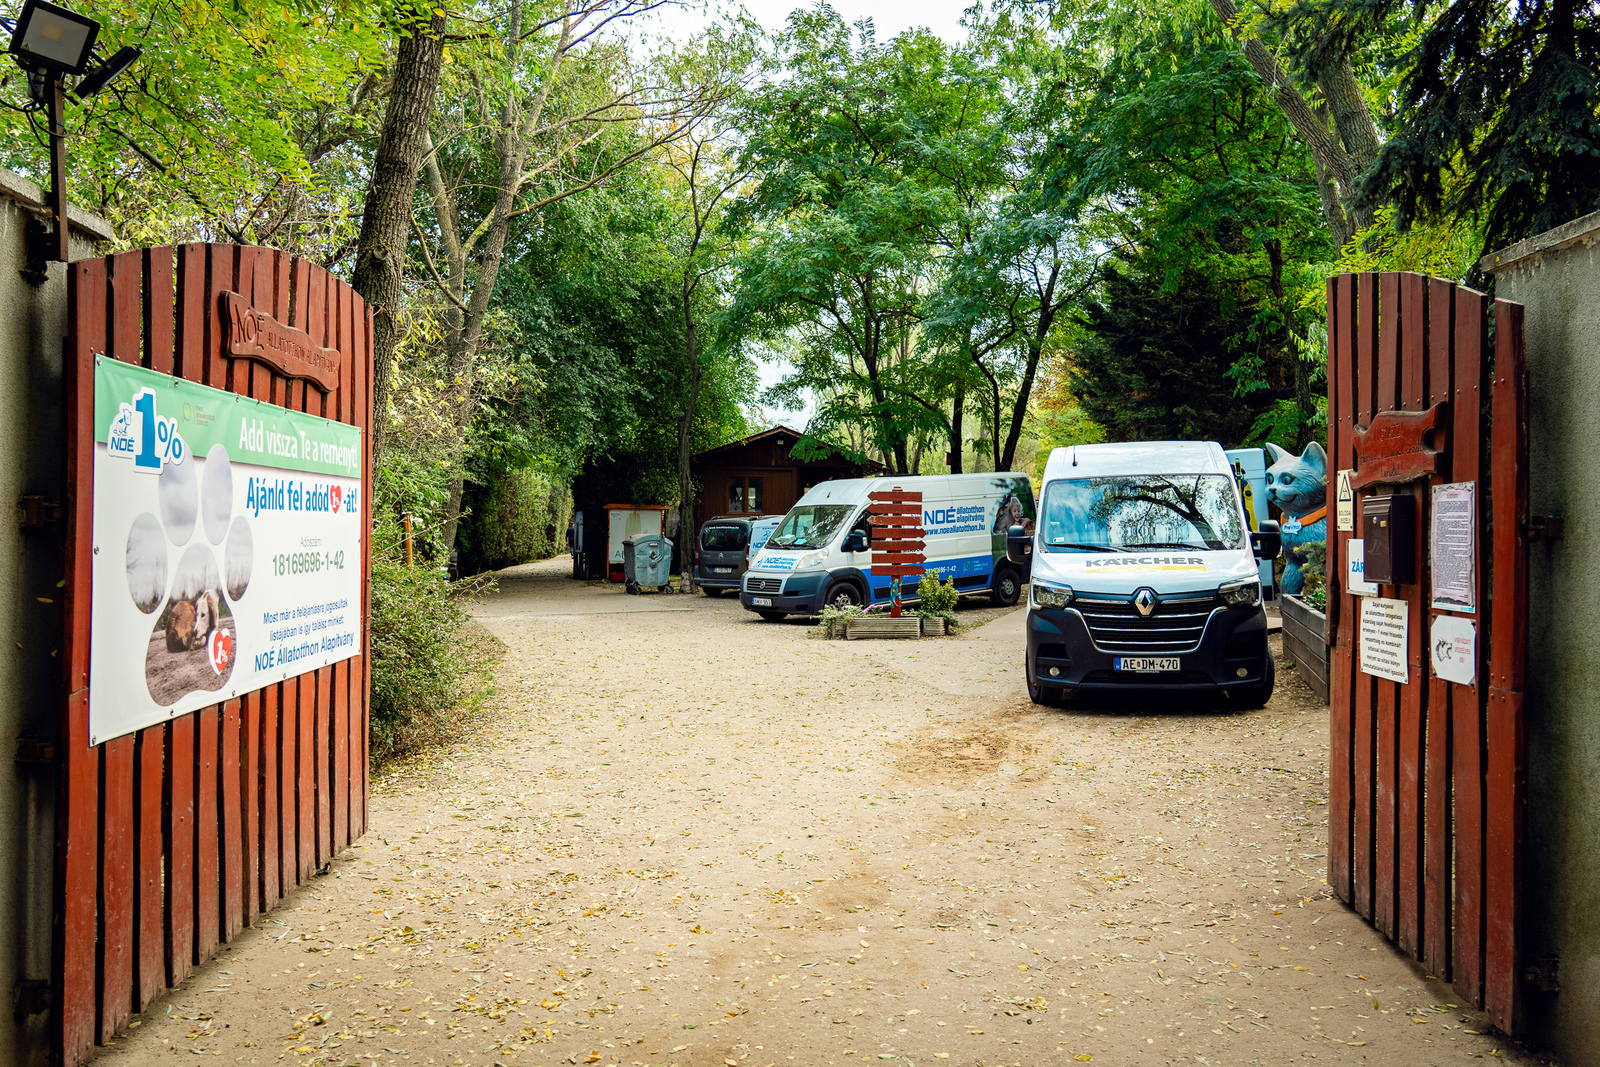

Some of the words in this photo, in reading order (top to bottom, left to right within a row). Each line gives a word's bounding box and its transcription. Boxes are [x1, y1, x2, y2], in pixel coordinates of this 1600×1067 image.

[135, 393, 182, 468] 1%
[111, 437, 134, 452] NOÉ
[239, 417, 264, 453] Add
[266, 424, 298, 458] vissza
[300, 430, 311, 460] Te
[312, 440, 319, 461] a
[320, 438, 358, 474] reményt!
[246, 477, 285, 518] Ajánld
[287, 480, 303, 511] fel
[305, 483, 329, 512] adód
[343, 486, 358, 513] -át!
[924, 506, 956, 525] NOÉ
[957, 505, 985, 515] állatotthon
[273, 550, 344, 576] 18169696-1-42
[1086, 557, 1205, 567] KÄRCHER
[1352, 559, 1364, 573] ZÁR
[263, 611, 279, 624] Most
[280, 609, 291, 621] már
[292, 610, 296, 619] a
[298, 624, 303, 634] is
[216, 641, 228, 664] 1%
[254, 645, 275, 673] NOÉ
[277, 642, 319, 666] Állatotthon
[321, 630, 355, 652] Alapítvány
[1123, 659, 1136, 669] AE
[1141, 659, 1179, 669] DM-470
